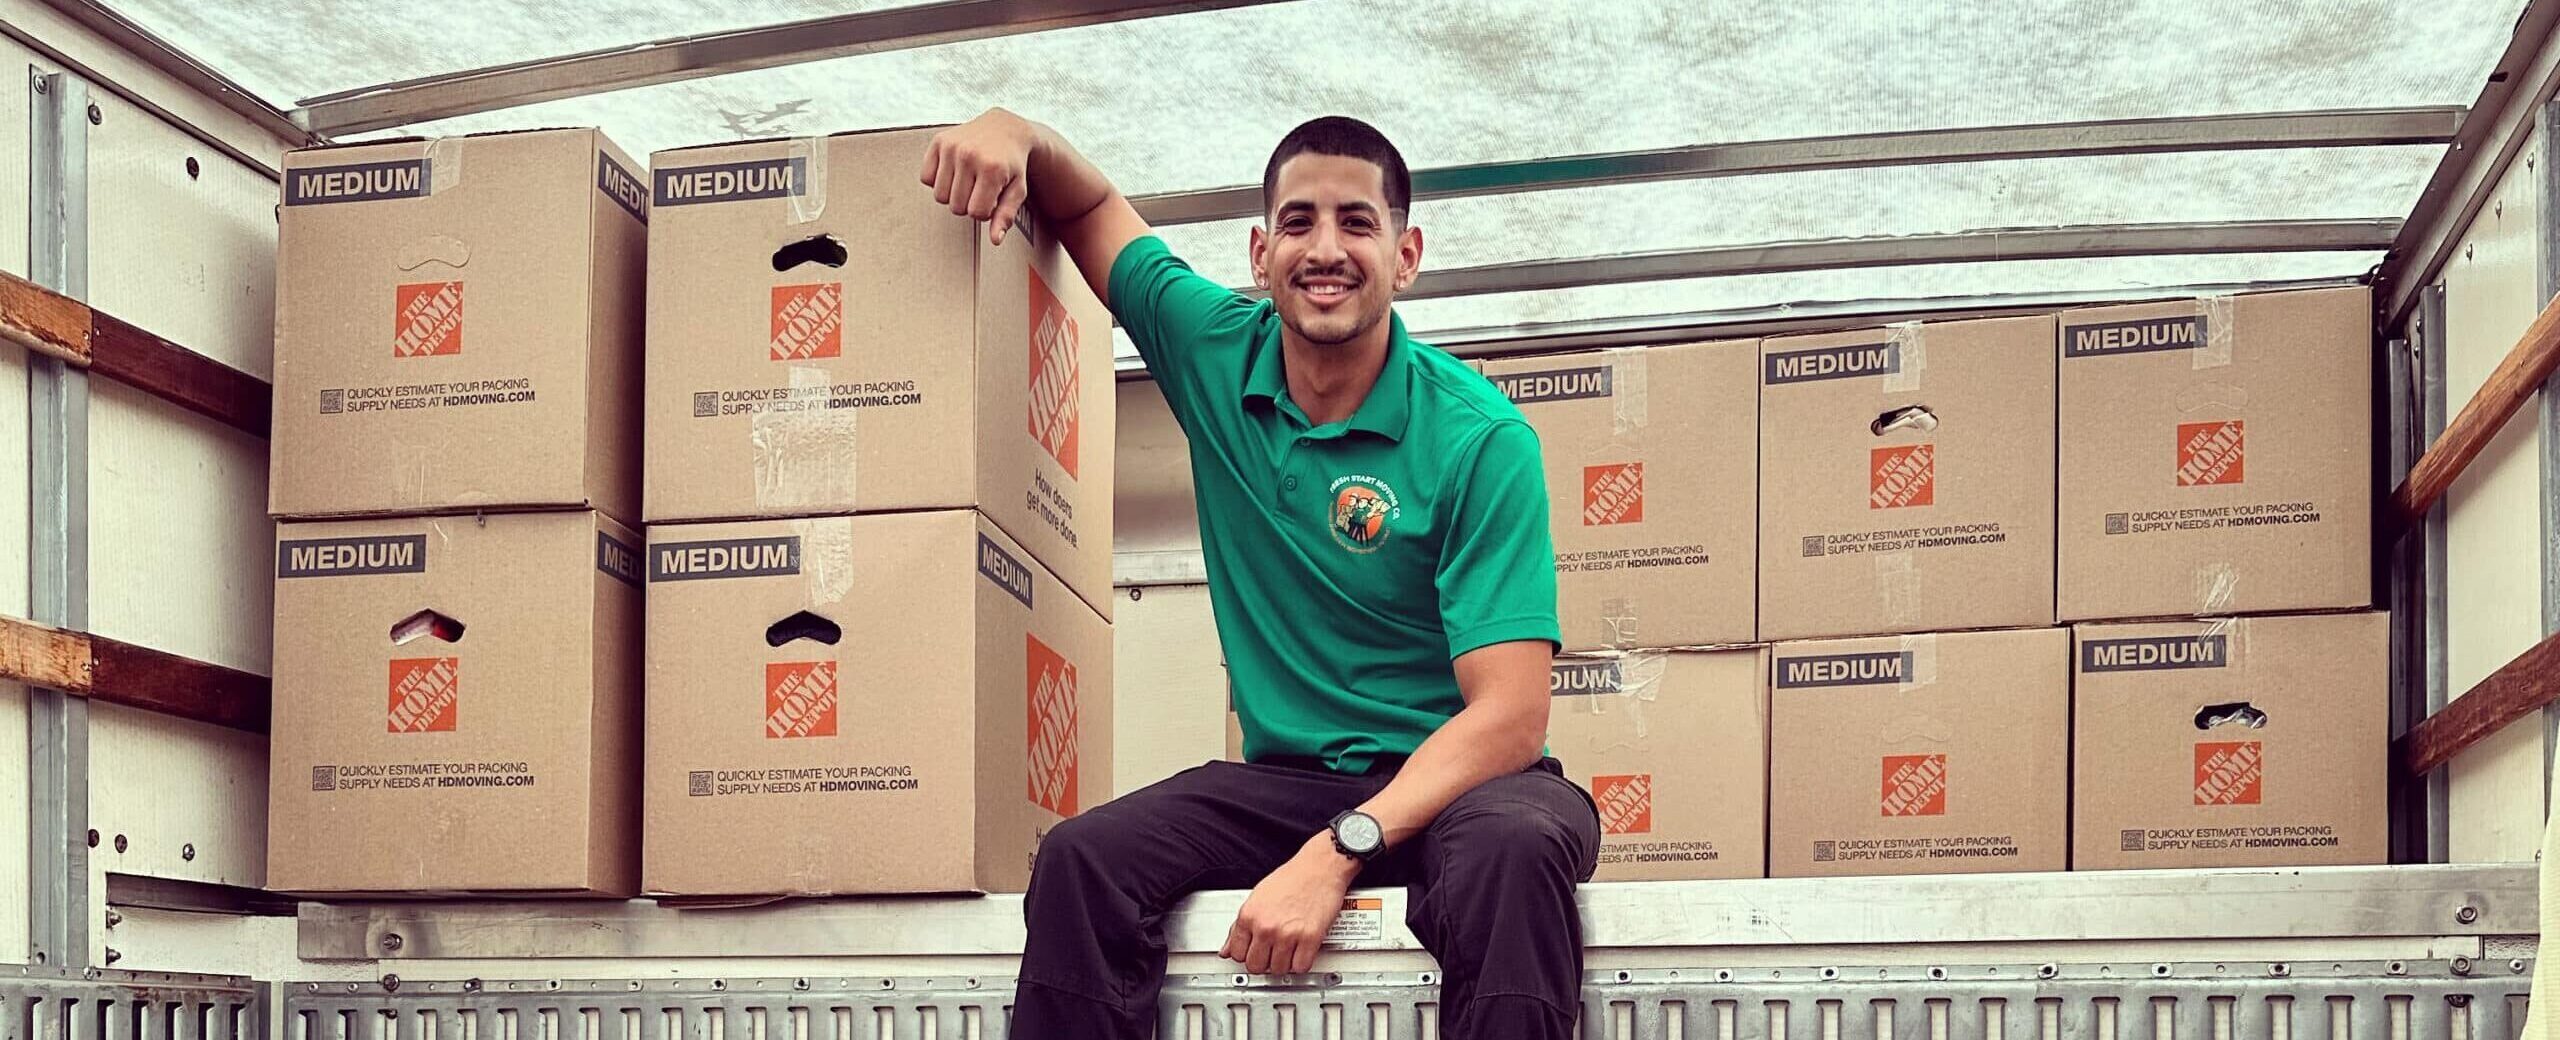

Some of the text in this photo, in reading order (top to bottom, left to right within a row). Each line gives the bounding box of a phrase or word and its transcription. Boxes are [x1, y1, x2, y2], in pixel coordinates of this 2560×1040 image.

[298, 167, 420, 198] MEDIUM
[605, 163, 648, 216] MEDI
[667, 166, 793, 198] MEDIUM
[395, 282, 462, 356] HOME
[401, 291, 431, 320] THE
[778, 292, 807, 323] THE
[421, 309, 461, 356] DEPOT
[771, 284, 840, 359] HOME
[799, 310, 840, 359] DEPOT
[1034, 305, 1057, 360] THE
[2077, 322, 2195, 350] MEDIUM
[1029, 316, 1078, 441] HOME
[1777, 350, 1888, 378] MEDIUM
[348, 379, 528, 399] QUICKLY ESTIMATE YOUR PACKING
[722, 381, 914, 401] QUICKLY ESTIMATE YOUR PACKING
[1497, 373, 1601, 399] MEDIUM
[348, 391, 535, 412] SUPPLY NEEDS AT HDMOVING.COM
[722, 394, 921, 415] SUPPLY NEEDS AT HDMOVING.COM
[1050, 379, 1079, 459] DEPOT
[2178, 422, 2243, 484] HOME
[2184, 430, 2211, 455] THE
[1872, 446, 1933, 507] HOME
[1876, 453, 1903, 479] THE
[2203, 444, 2242, 483] DEPOT
[1036, 467, 1072, 519] How doers
[1351, 475, 1376, 484] START
[1375, 480, 1398, 507] MOVING
[1584, 463, 1641, 525] HOME
[1589, 471, 1614, 495] THE
[1895, 467, 1932, 507] DEPOT
[1027, 491, 1039, 512] get
[1041, 503, 1059, 530] more
[1607, 484, 1642, 522] DEPOT
[2133, 502, 2313, 521] QUICKLY ESTIMATE YOUR PACKING
[1828, 523, 1999, 544] QUICKLY ESTIMATE YOUR PACKING
[2133, 513, 2320, 532] SUPPLY NEEDS AT HDMOVING.COM
[291, 542, 413, 571] MEDIUM
[661, 544, 788, 574] MEDIUM
[1586, 551, 1629, 561] ESTIMATE
[1632, 548, 1659, 557] YOUR
[1662, 545, 1703, 555] PACKING
[1827, 533, 2005, 555] SUPPLY NEEDS AT HDMOVING.COM
[604, 542, 640, 580] MED
[983, 543, 1029, 599] MEDIUM
[1555, 556, 1708, 572] PPLY NEEDS AT HDMOVING.COM
[2094, 642, 2214, 666] MEDIUM
[395, 666, 424, 696] THE
[1552, 669, 1611, 690] DIUM
[1788, 658, 1901, 682] MEDIUM
[389, 659, 457, 732] HOME
[767, 662, 835, 737] HOME
[773, 670, 802, 701] THE
[1033, 663, 1055, 724] THE
[415, 684, 456, 731] DEPOT
[795, 689, 836, 736] DEPOT
[1028, 660, 1077, 805] HOME
[340, 762, 527, 777] QUICKLY ESTIMATE YOUR PACKING
[718, 766, 911, 782] QUICKLY ESTIMATE YOUR PACKING
[1048, 724, 1078, 812] DEPOT
[1888, 761, 1915, 786] THE
[2195, 742, 2261, 805] HOME
[2201, 749, 2229, 774] THE
[340, 776, 534, 790] SUPPLY NEEDS AT HDMOVING.COM
[717, 779, 918, 795] SUPPLY NEEDS AT HDMOVING.COM
[1598, 781, 1624, 805] THE
[1882, 755, 1945, 815] HOME
[1907, 777, 1944, 815] DEPOT
[2221, 765, 2260, 804] DEPOT
[1615, 796, 1650, 833] DEPOT
[1600, 842, 1712, 853] STIMATE YOUR PACKING
[1839, 837, 2012, 850] QUICKLY ESTIMATE YOUR PACKING
[2148, 826, 2331, 839] QUICKLY ESTIMATE YOUR PACKING
[2148, 837, 2338, 849] SUPPLY NEEDS AT HDMOVING.COM
[1598, 852, 1718, 863] EEDS AT HDMOVING.COM
[1839, 847, 2018, 860] SUPPLY NEEDS AT HDMOVING.COM
